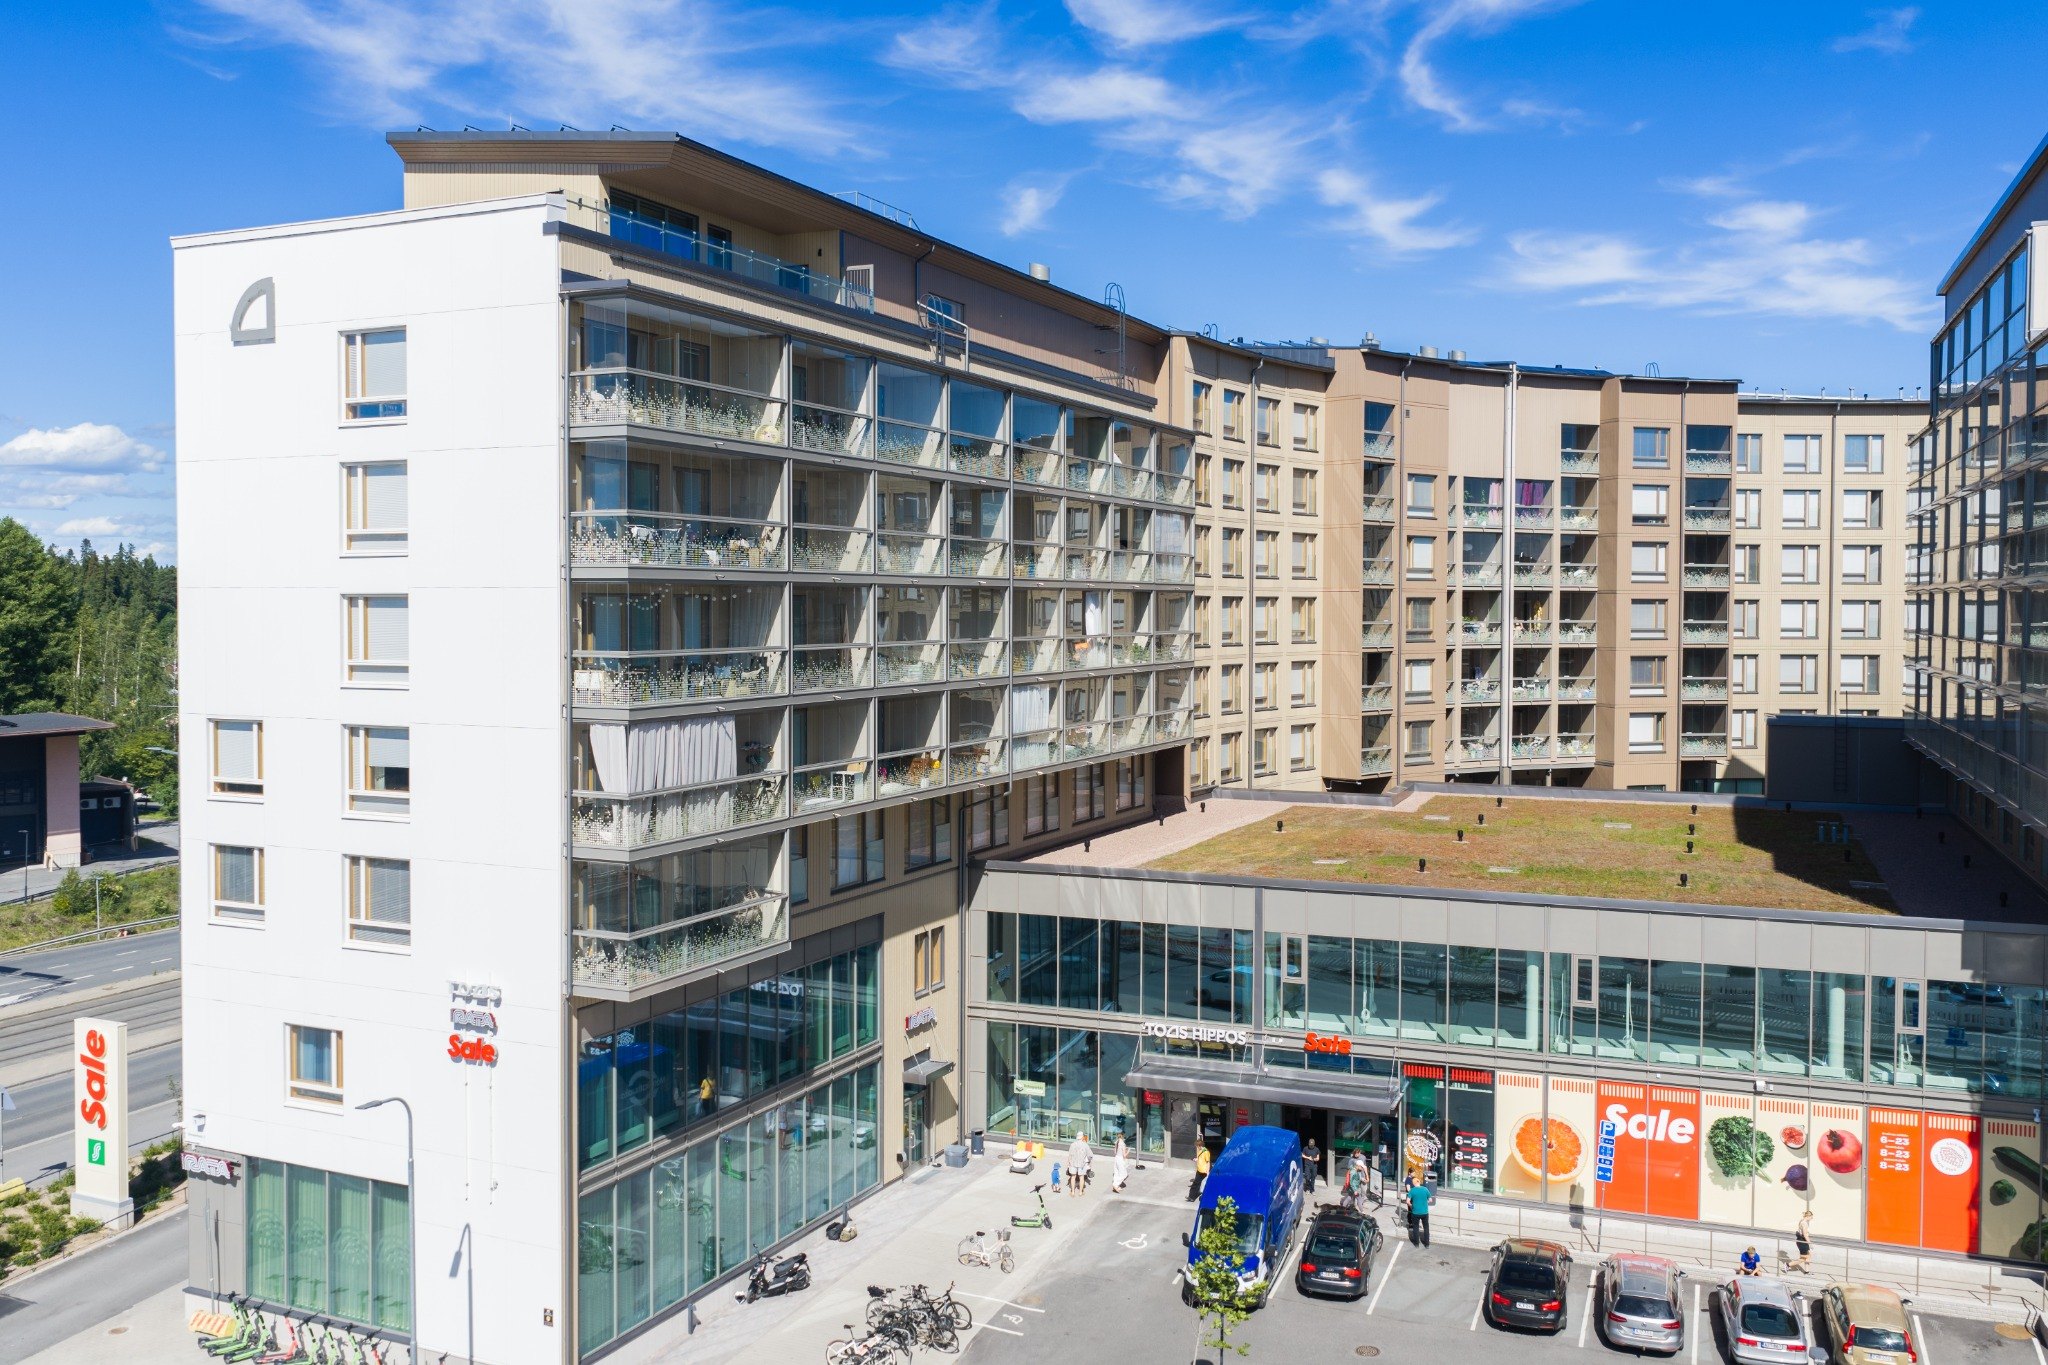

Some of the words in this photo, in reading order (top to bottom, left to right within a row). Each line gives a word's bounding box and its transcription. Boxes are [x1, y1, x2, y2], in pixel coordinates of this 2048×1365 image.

[447, 1034, 498, 1063] Sale
[1192, 1026, 1247, 1045] HIPPOS
[1304, 1031, 1352, 1054] Sale
[80, 1029, 107, 1130] Sale
[1602, 1121, 1614, 1134] P
[1606, 1103, 1695, 1144] Sale
